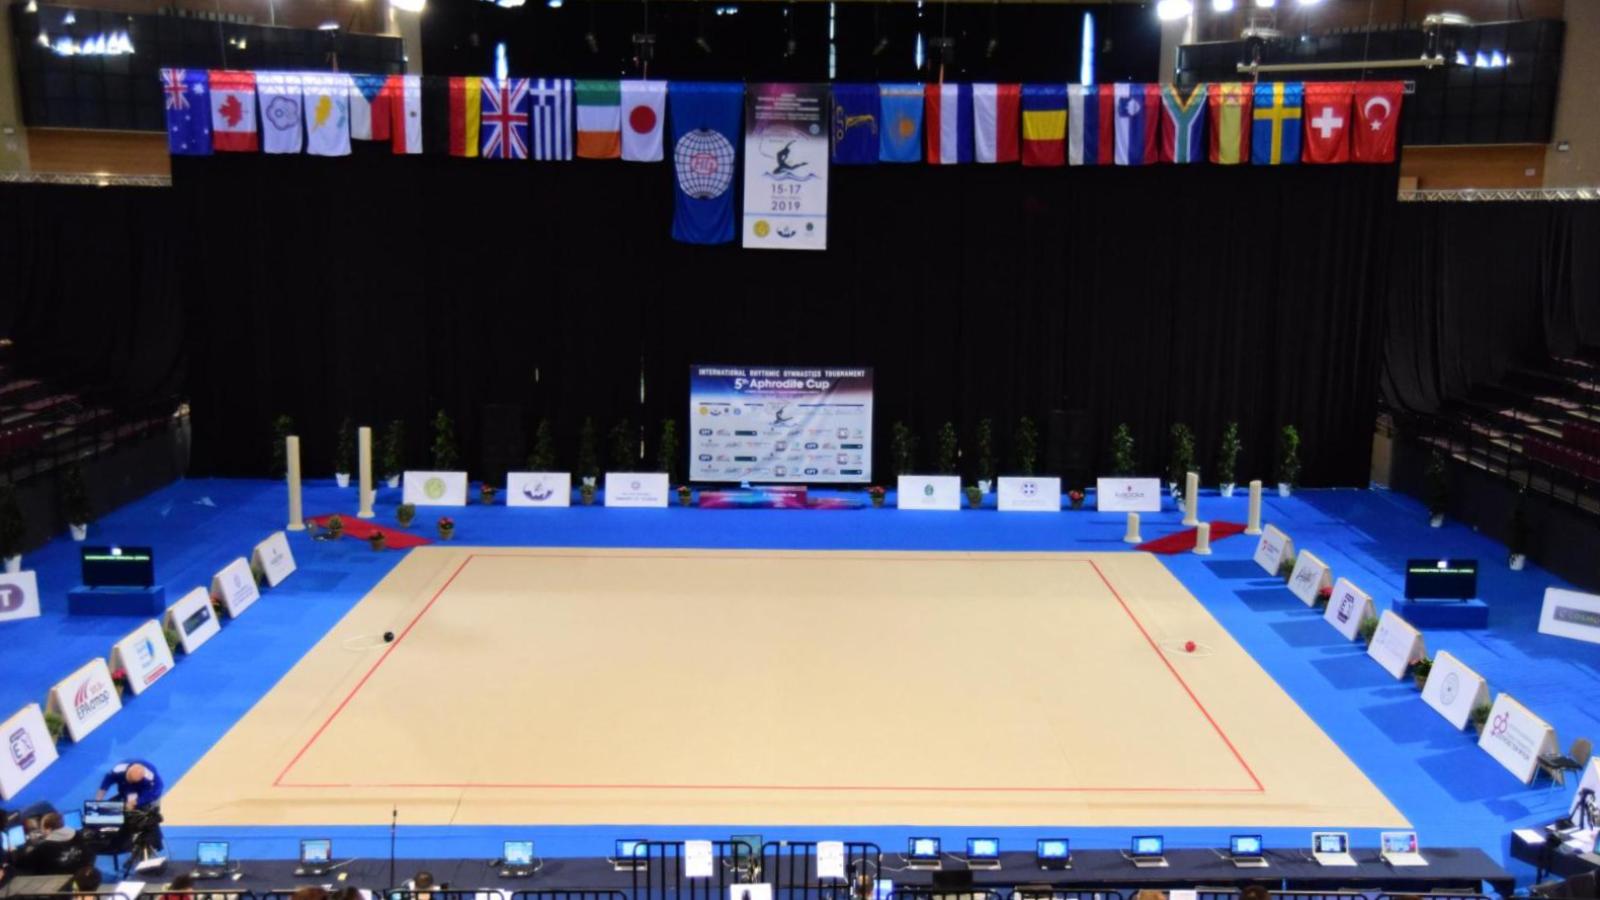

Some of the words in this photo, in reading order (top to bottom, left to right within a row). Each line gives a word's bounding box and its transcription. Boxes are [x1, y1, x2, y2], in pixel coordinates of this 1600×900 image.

[771, 200, 801, 211] 2019
[698, 368, 747, 377] INTERNATIONAL
[783, 370, 822, 378] GYMNASTICS
[825, 370, 865, 378] TOURNAMENT
[750, 378, 804, 391] Aphrodite
[806, 379, 830, 391] Cup
